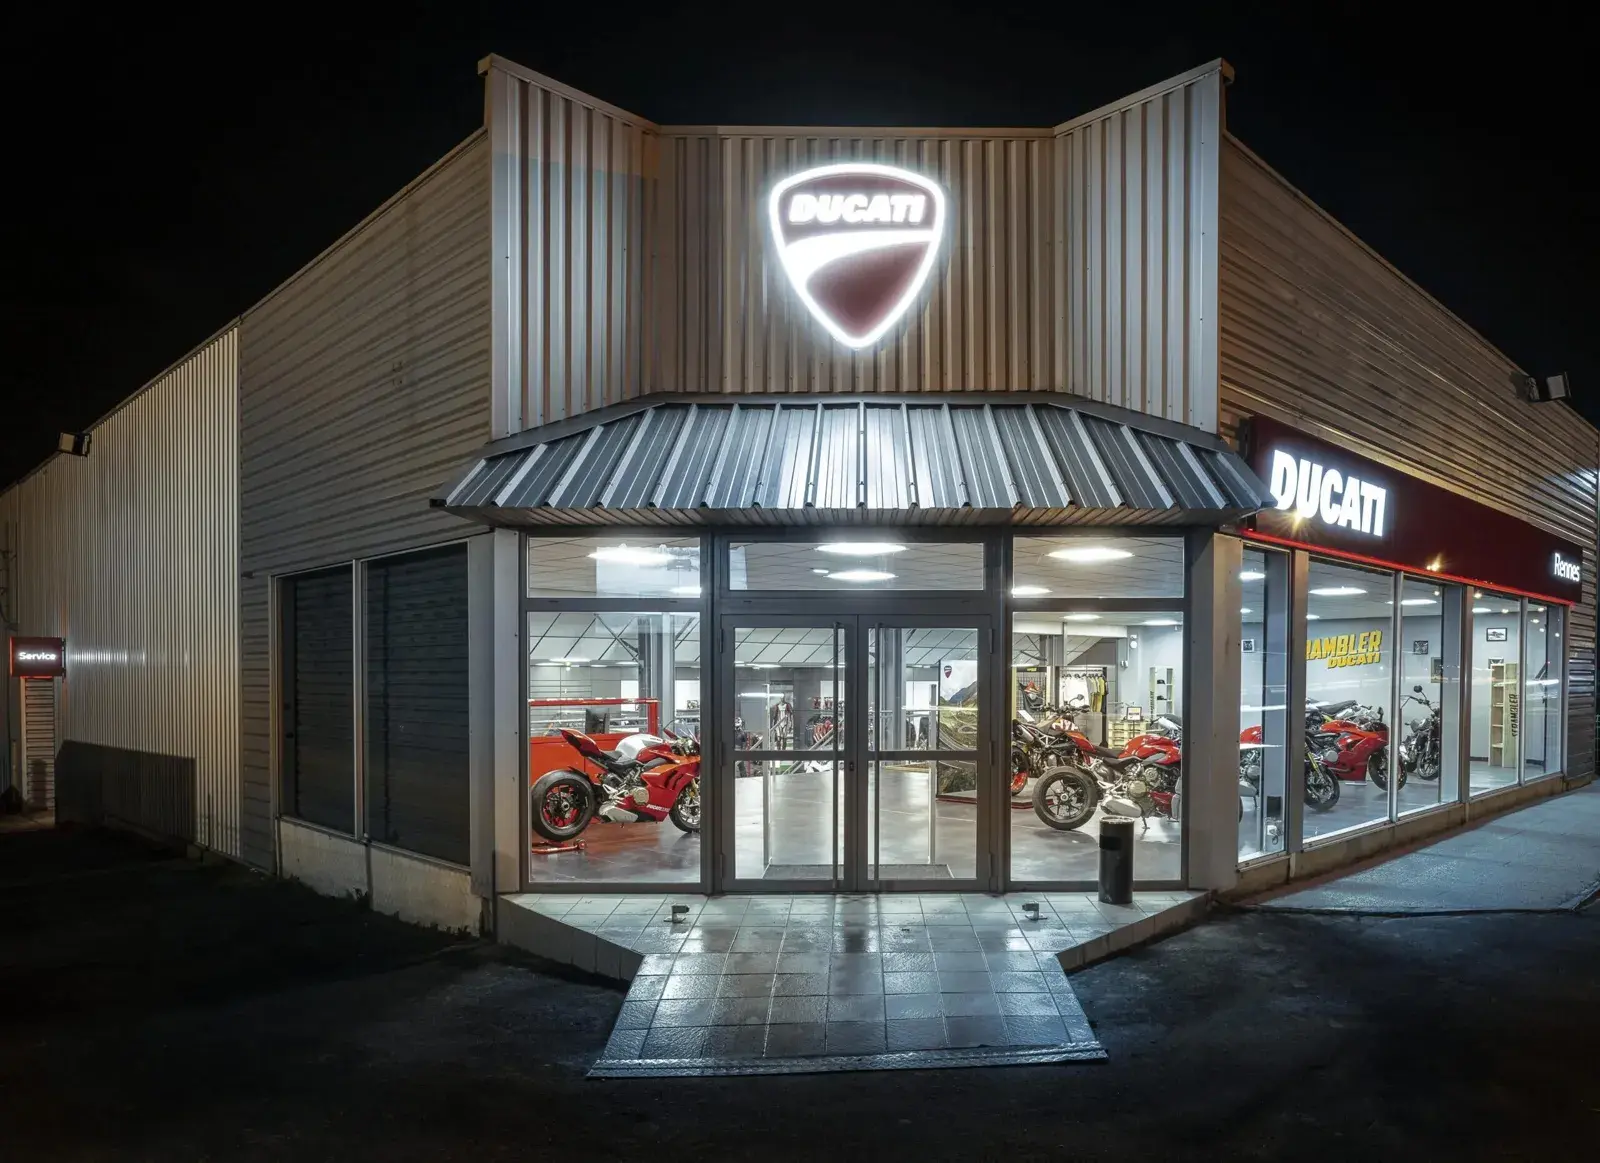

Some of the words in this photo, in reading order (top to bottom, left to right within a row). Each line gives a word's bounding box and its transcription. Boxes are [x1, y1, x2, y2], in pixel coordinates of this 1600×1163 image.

[788, 194, 926, 223] DUCATI
[1269, 449, 1387, 537] DUCATI
[1554, 552, 1580, 582] Rennes
[18, 651, 57, 660] Service
[1327, 652, 1381, 669] DUCATI
